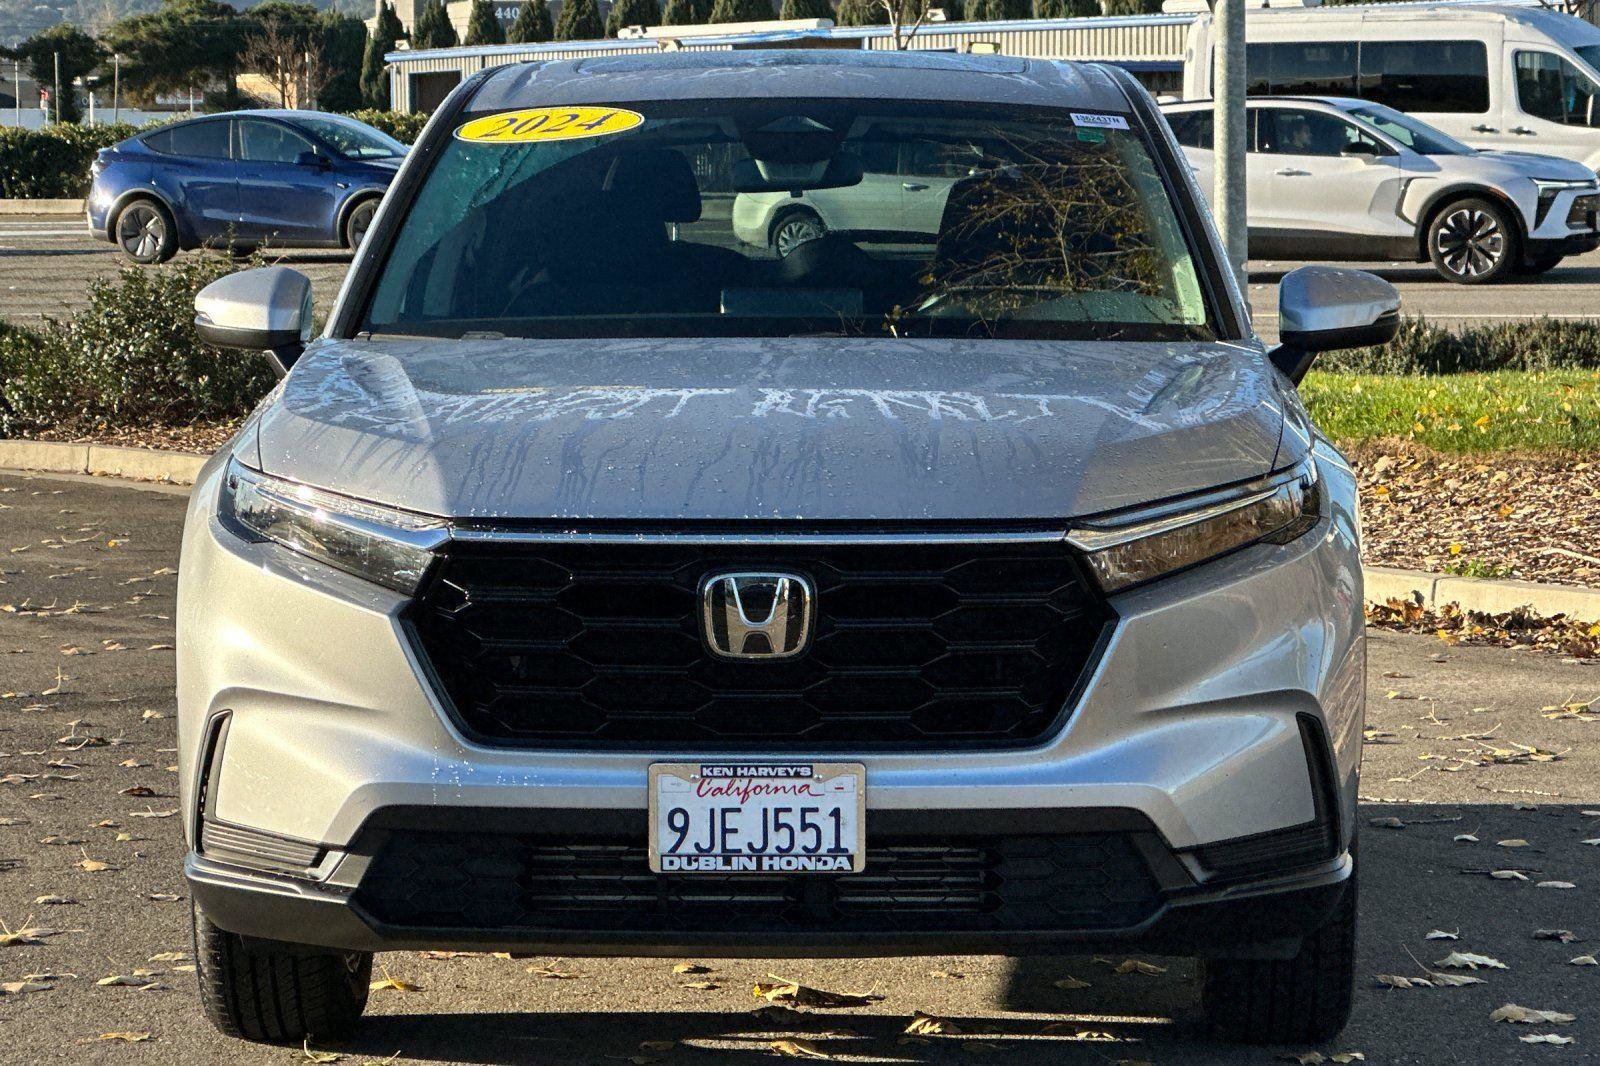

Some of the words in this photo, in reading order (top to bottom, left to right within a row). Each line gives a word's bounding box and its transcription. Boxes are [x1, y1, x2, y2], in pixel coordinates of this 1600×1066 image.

[495, 6, 520, 19] 440
[477, 112, 618, 137] 2024
[702, 767, 733, 776] KEN
[736, 767, 812, 776] HARVEY'S
[696, 778, 825, 804] California
[667, 807, 849, 854] 9JEJ551
[662, 857, 757, 870] DUBLIN
[762, 857, 852, 870] HONDA
